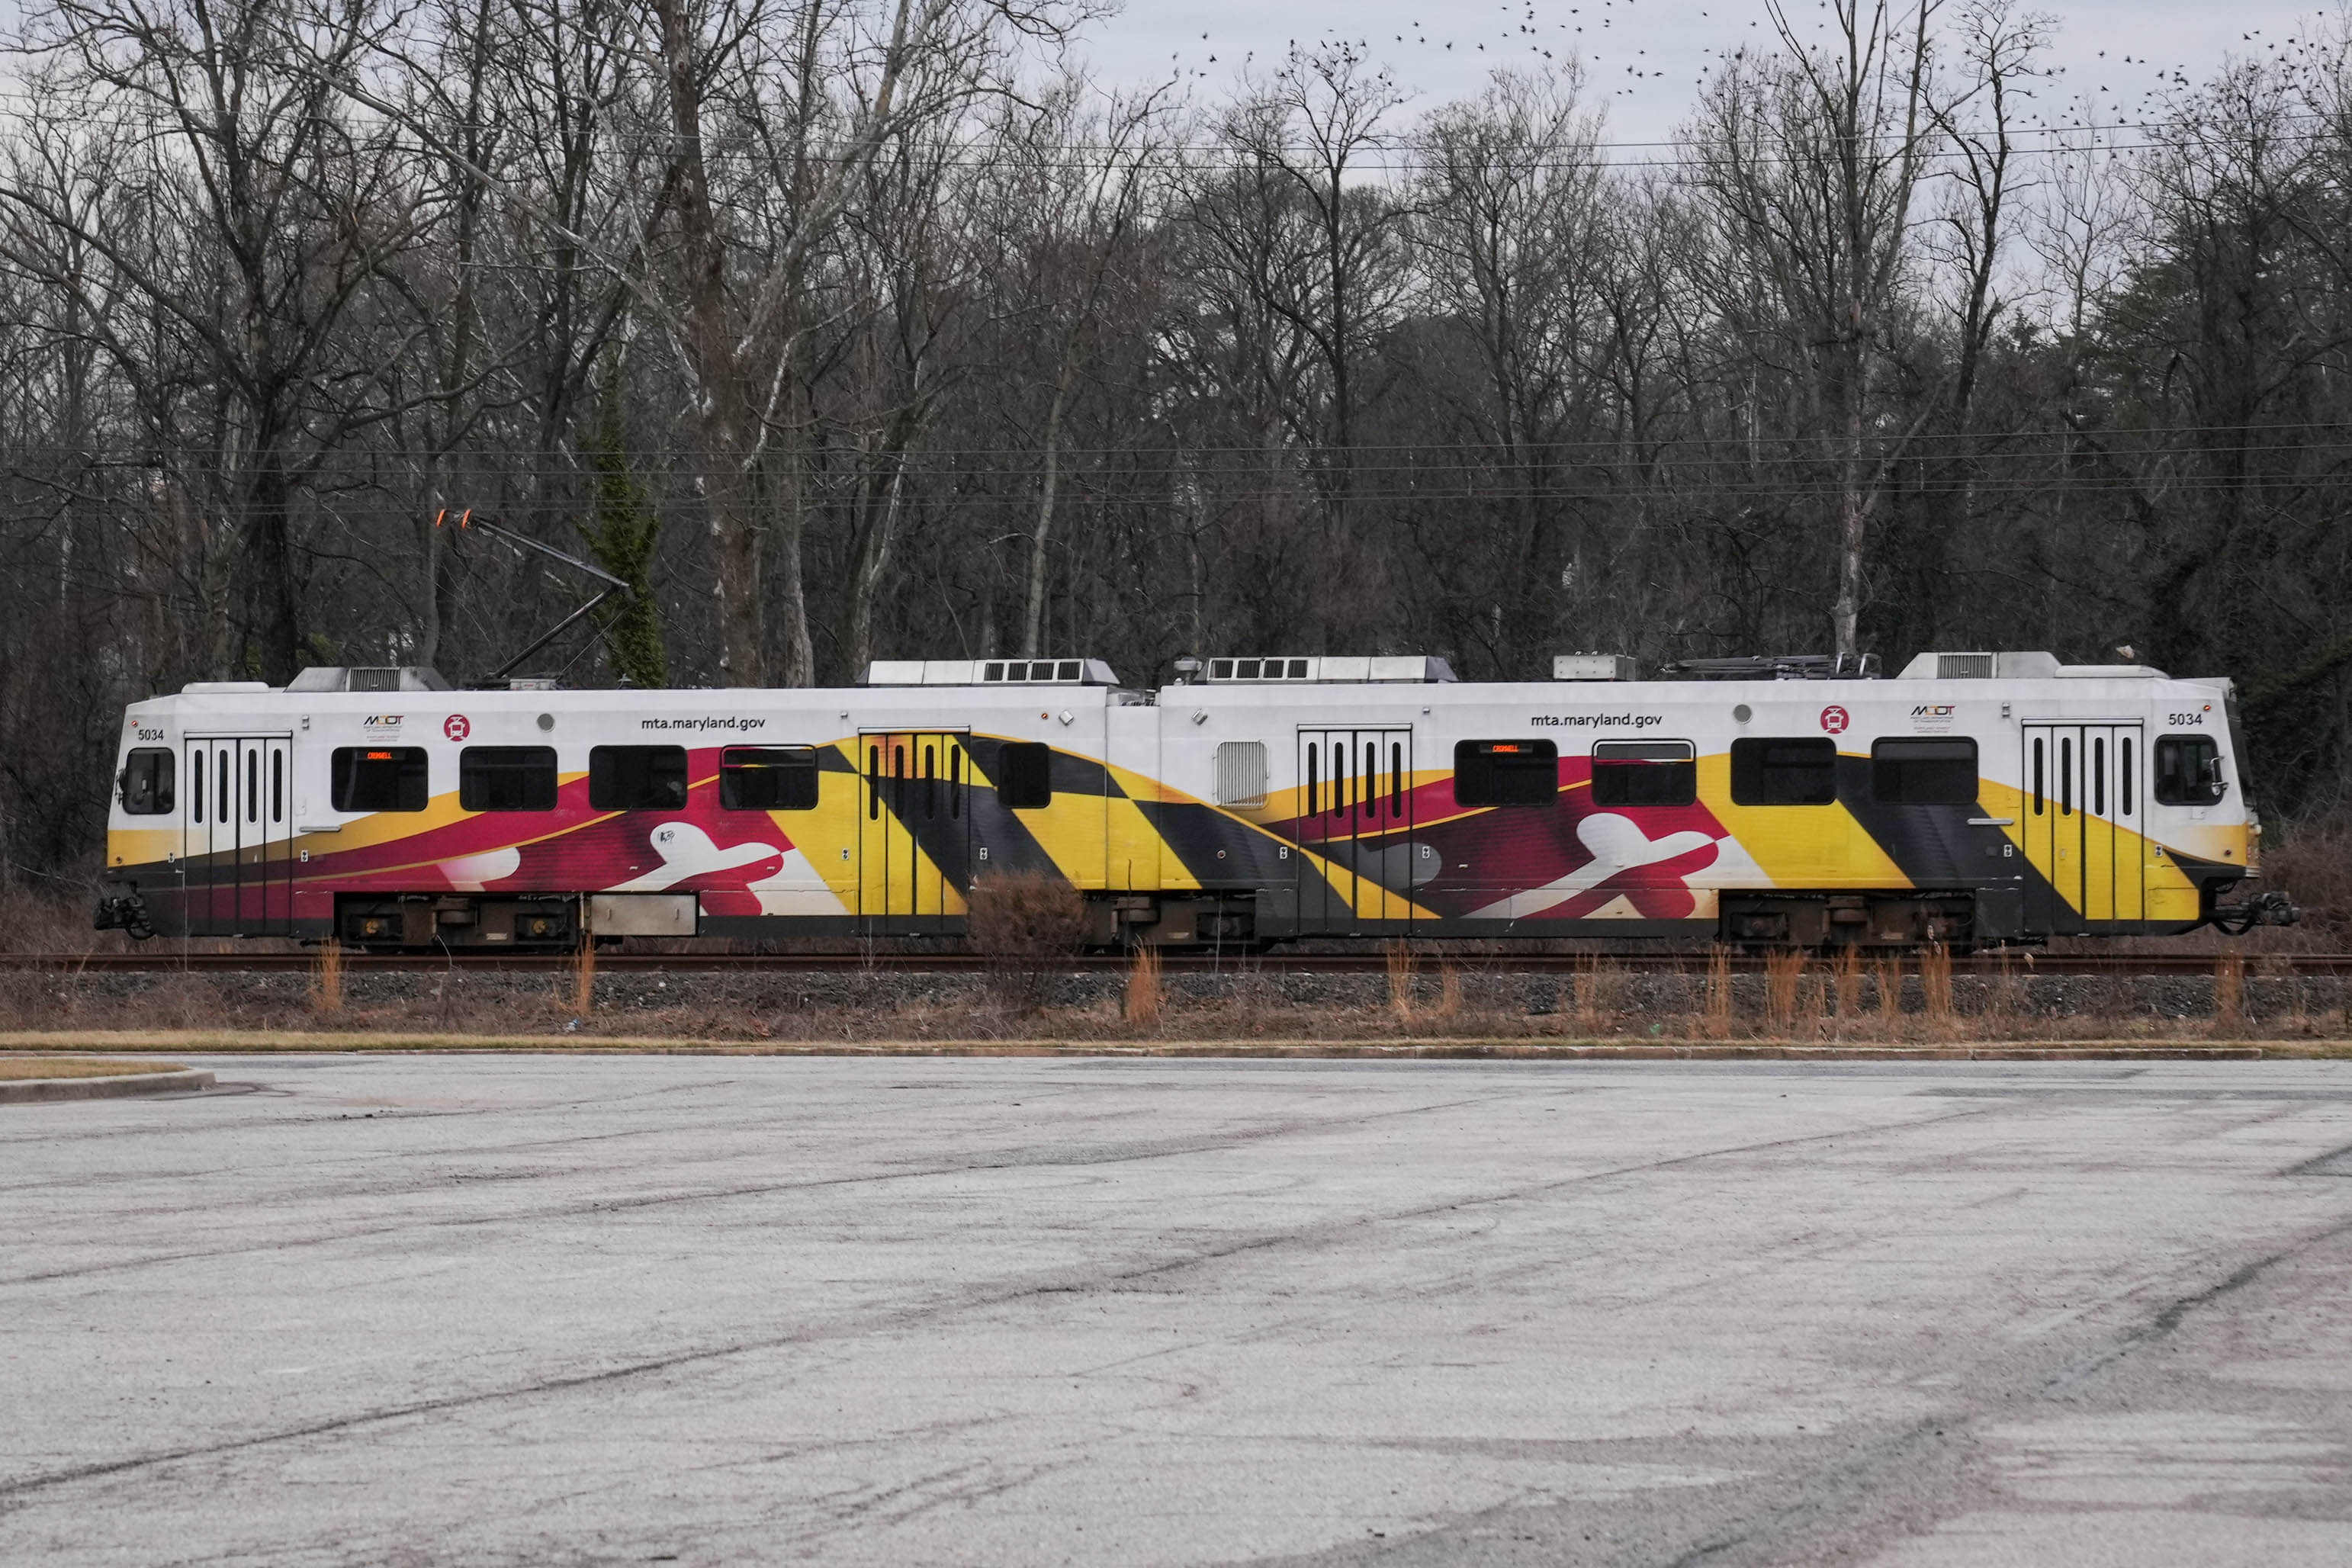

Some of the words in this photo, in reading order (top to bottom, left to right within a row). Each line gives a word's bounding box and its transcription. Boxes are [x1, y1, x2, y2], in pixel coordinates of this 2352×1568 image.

[641, 716, 765, 732] mta.maryland.gov
[1531, 713, 1663, 728] mta.maryland.gov
[2168, 714, 2203, 725] 5034
[138, 729, 164, 741] 5034
